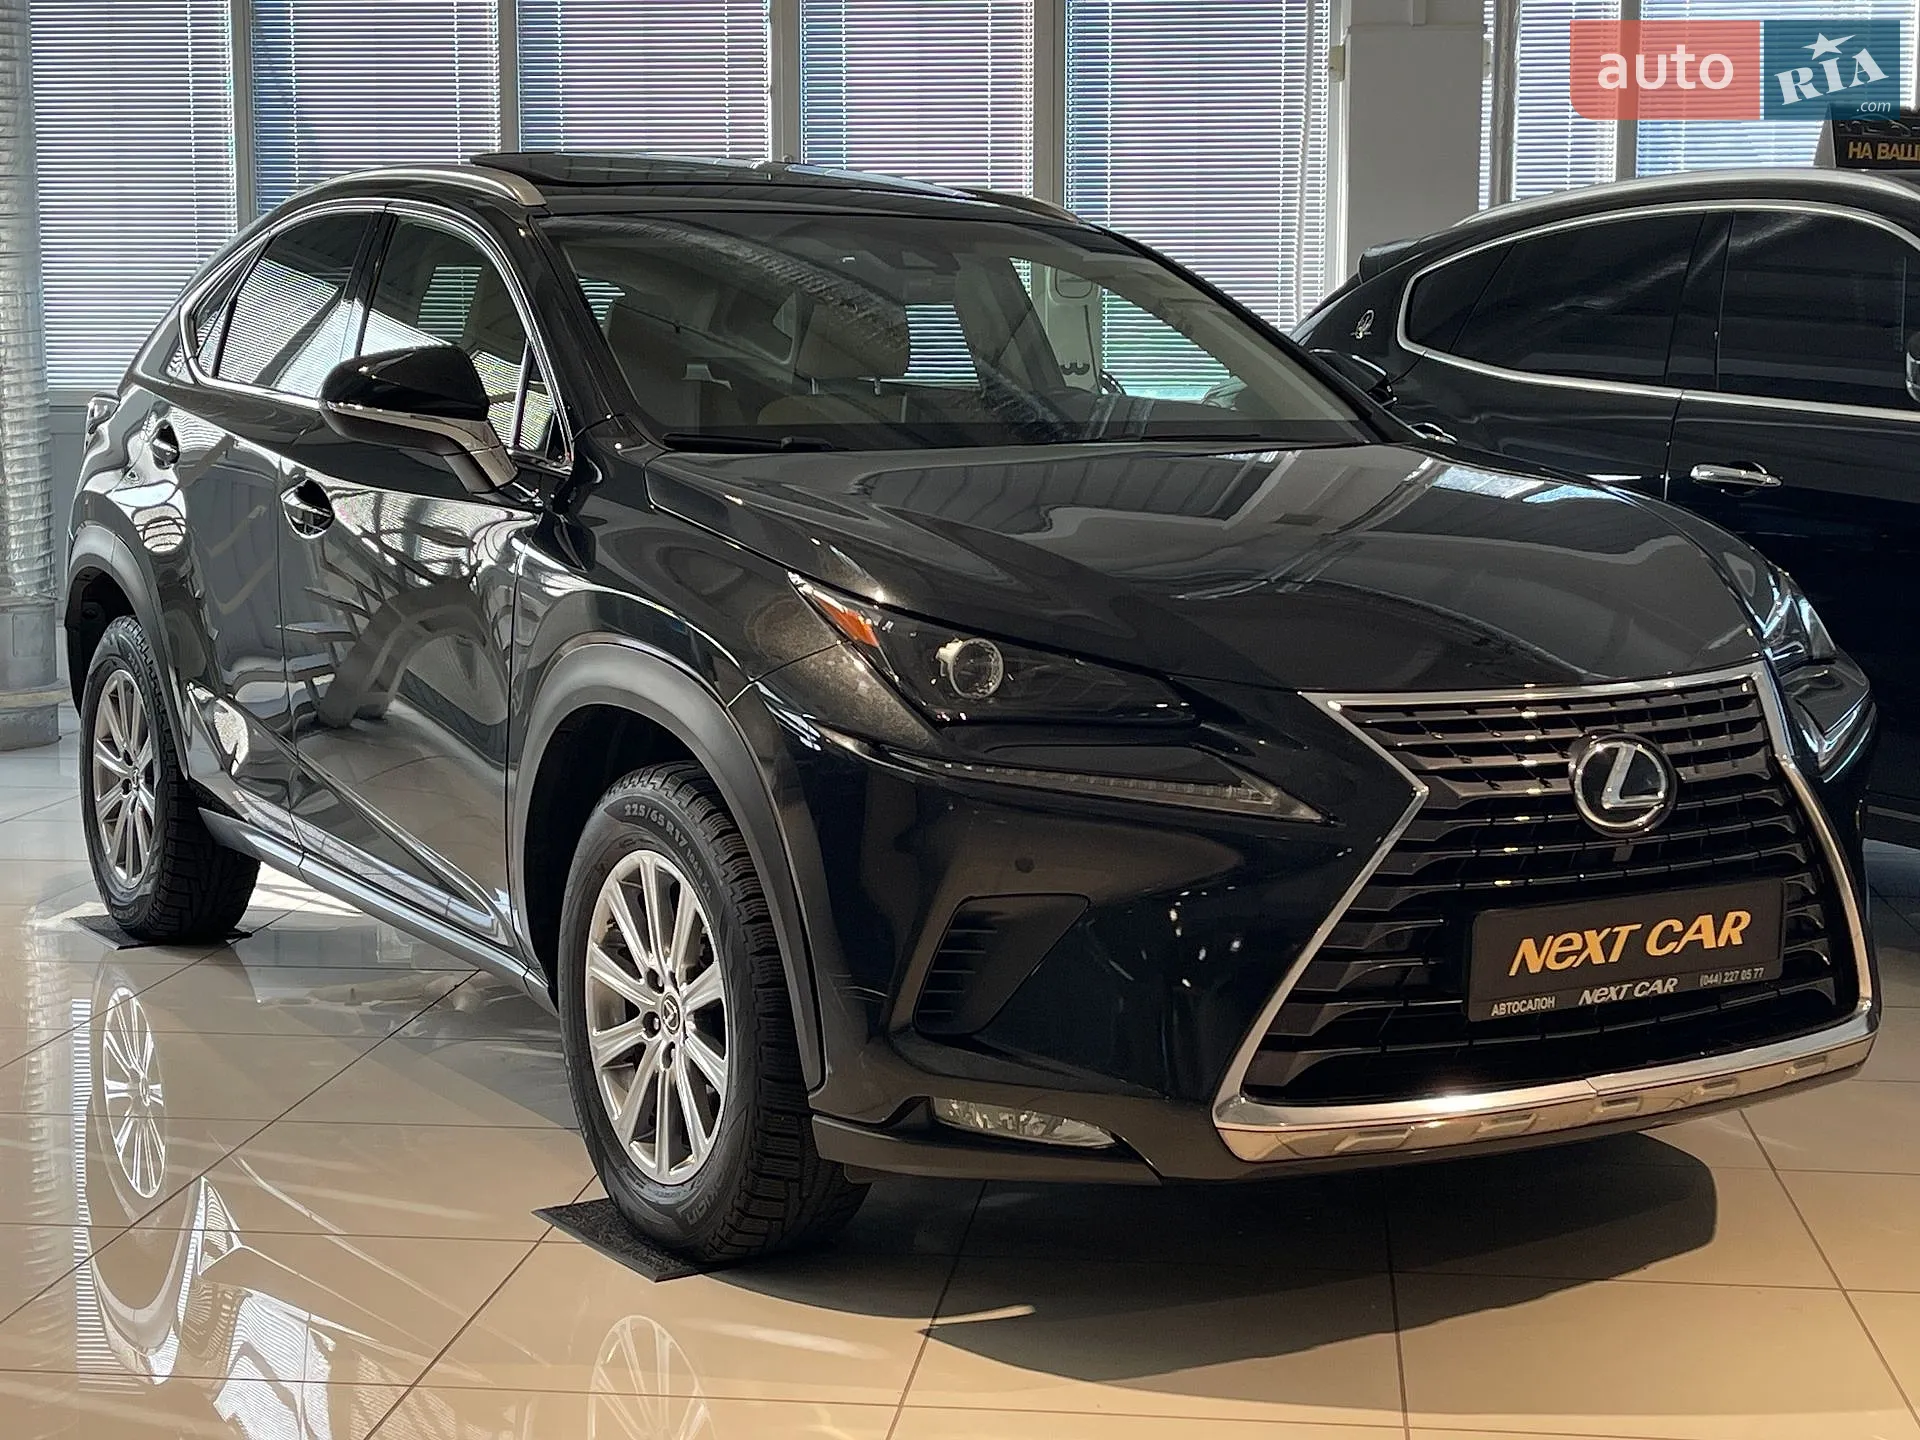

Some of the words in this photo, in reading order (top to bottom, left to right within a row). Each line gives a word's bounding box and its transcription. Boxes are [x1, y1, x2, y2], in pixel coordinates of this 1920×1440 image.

[1848, 141, 1873, 159] НА
[1877, 143, 1920, 160] ВАШ
[1646, 910, 1751, 956] CAR
[1490, 996, 1556, 1017] АВТОСАЛОН
[1633, 977, 1679, 998] CAR
[1700, 971, 1723, 987] (044)
[1723, 970, 1740, 984] 227
[1740, 968, 1753, 981] 05
[1753, 967, 1764, 979] 77
